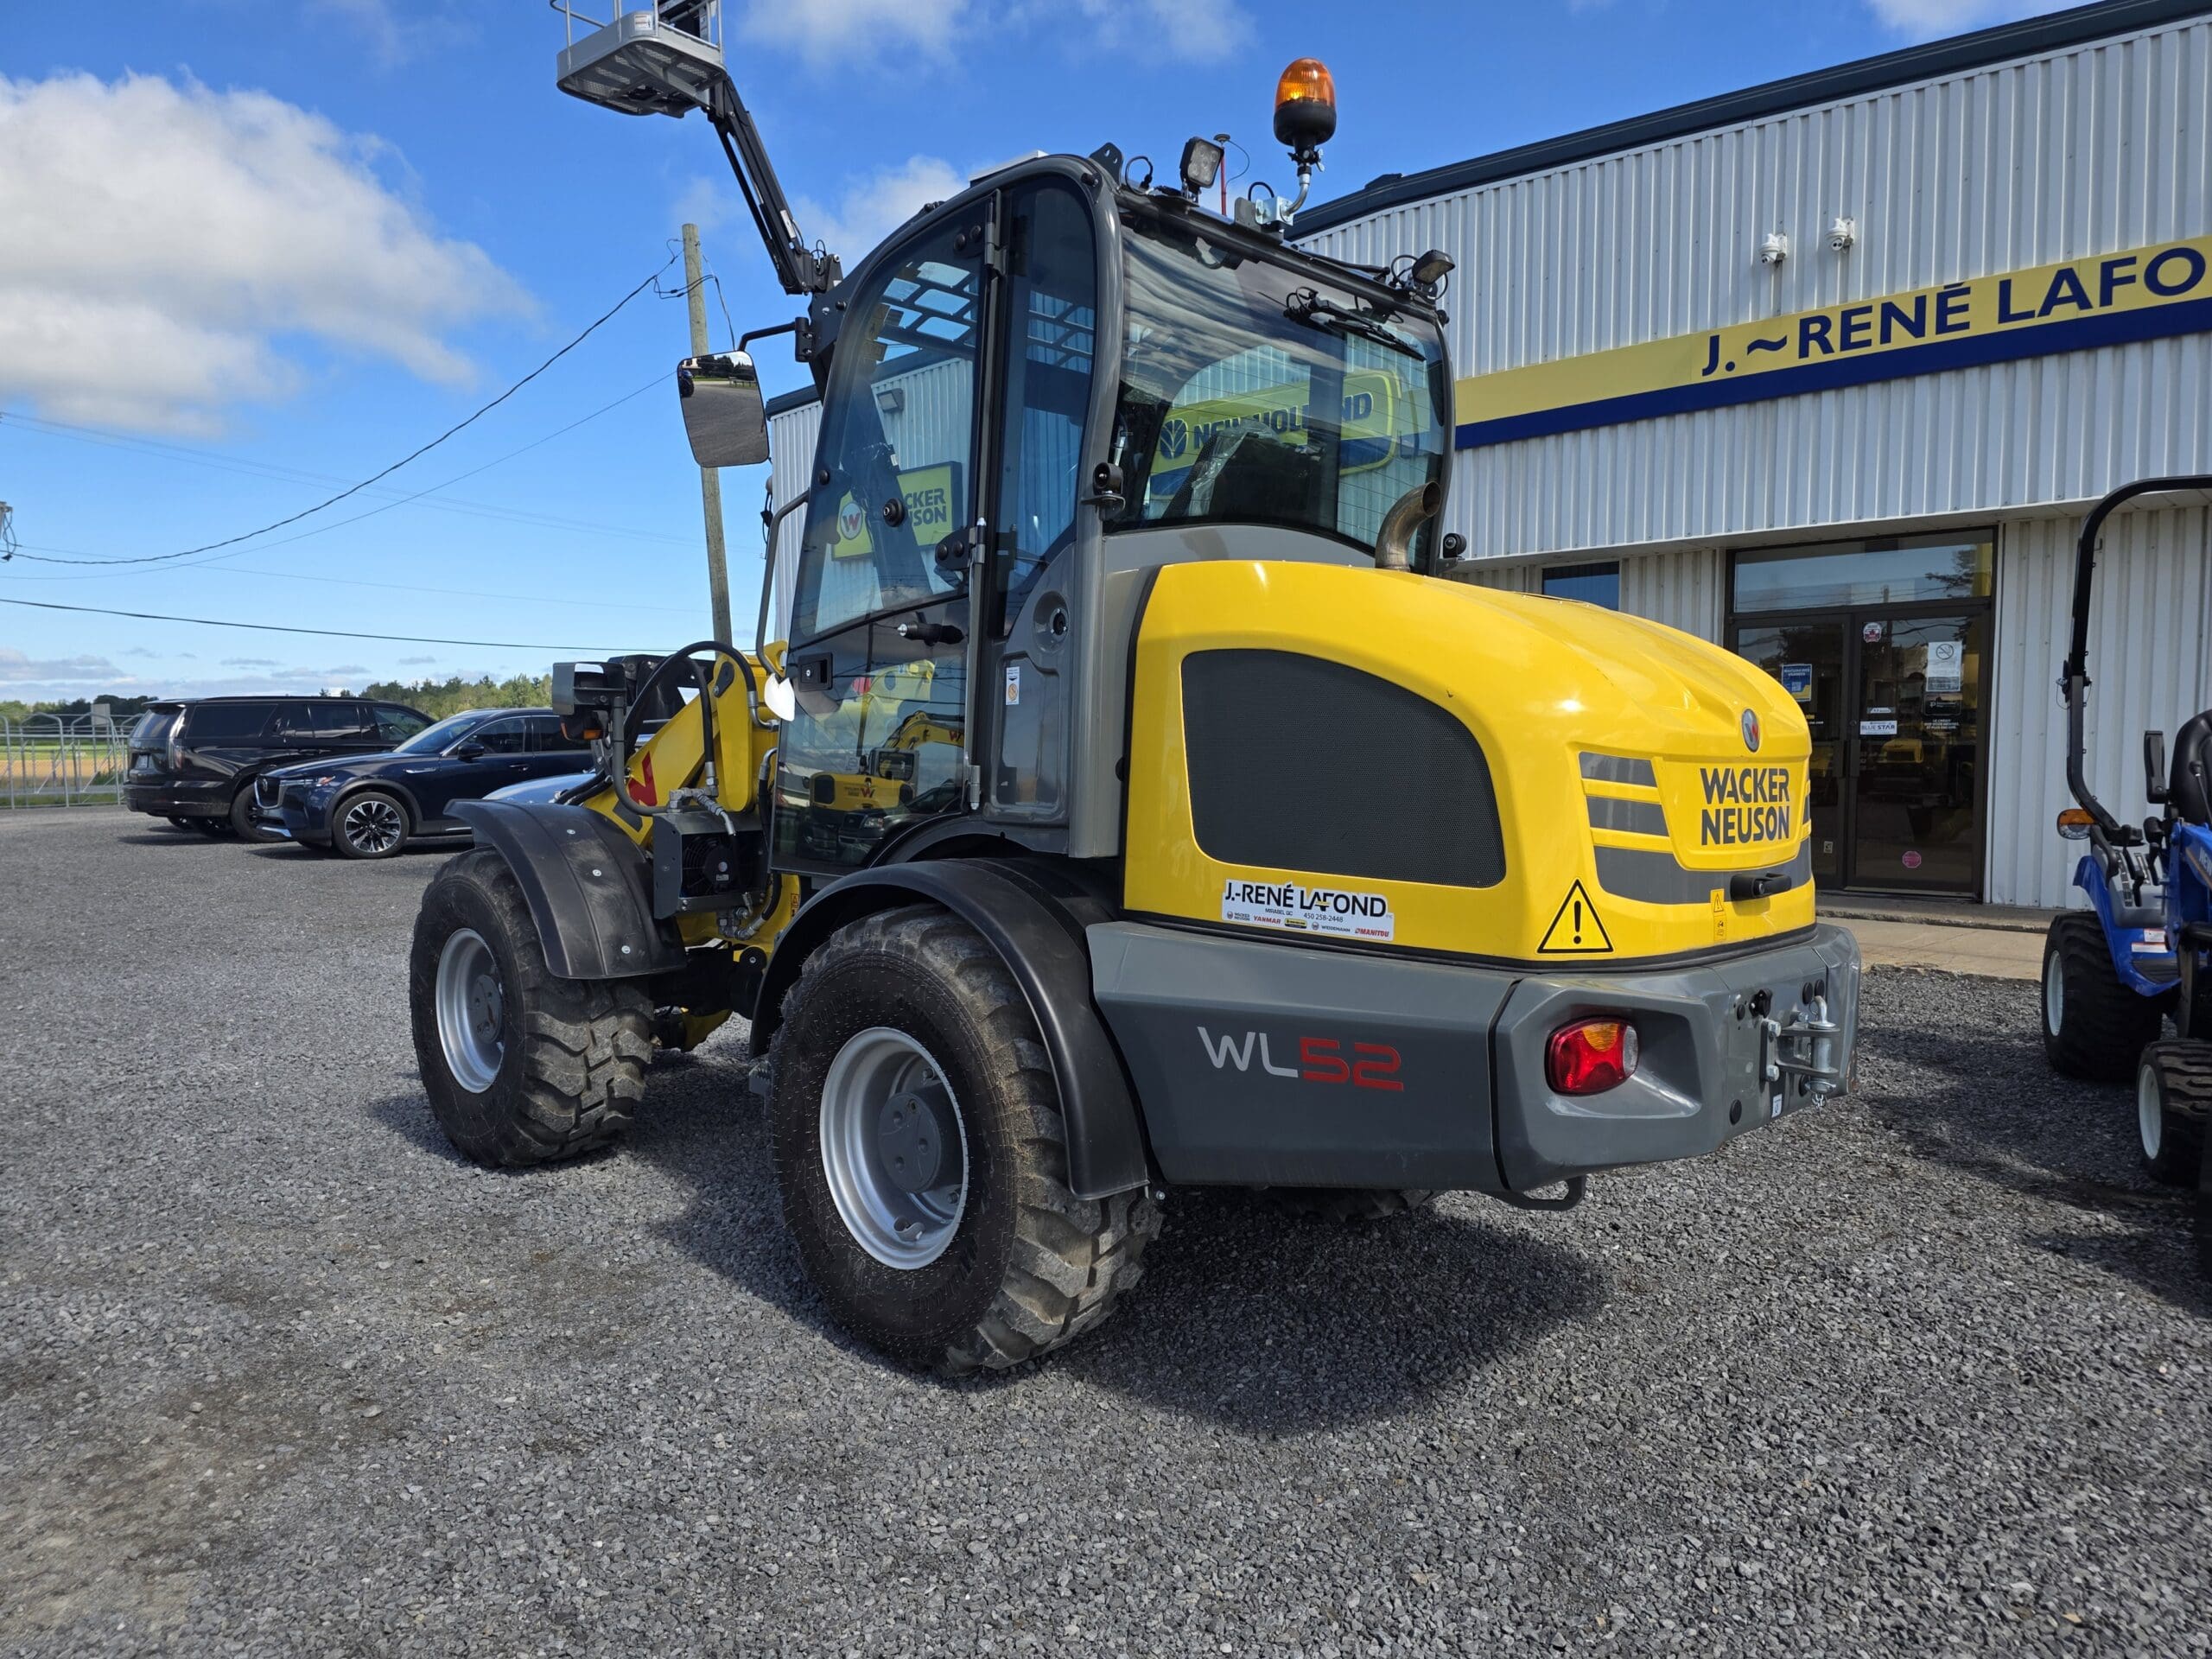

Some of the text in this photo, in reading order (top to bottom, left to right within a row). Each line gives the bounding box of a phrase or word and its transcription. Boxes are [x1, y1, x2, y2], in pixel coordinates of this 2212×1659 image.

[904, 488, 946, 510] CKER
[1700, 768, 1789, 804] WACKER
[1701, 806, 1789, 846] NEUSON
[1225, 882, 1387, 918] J.-RENÉ LAFOND
[1253, 915, 1281, 925] YANMAR
[1315, 913, 1344, 923] 258-2448
[1359, 927, 1389, 938] MANITOU
[1196, 1026, 1404, 1092] WL52
